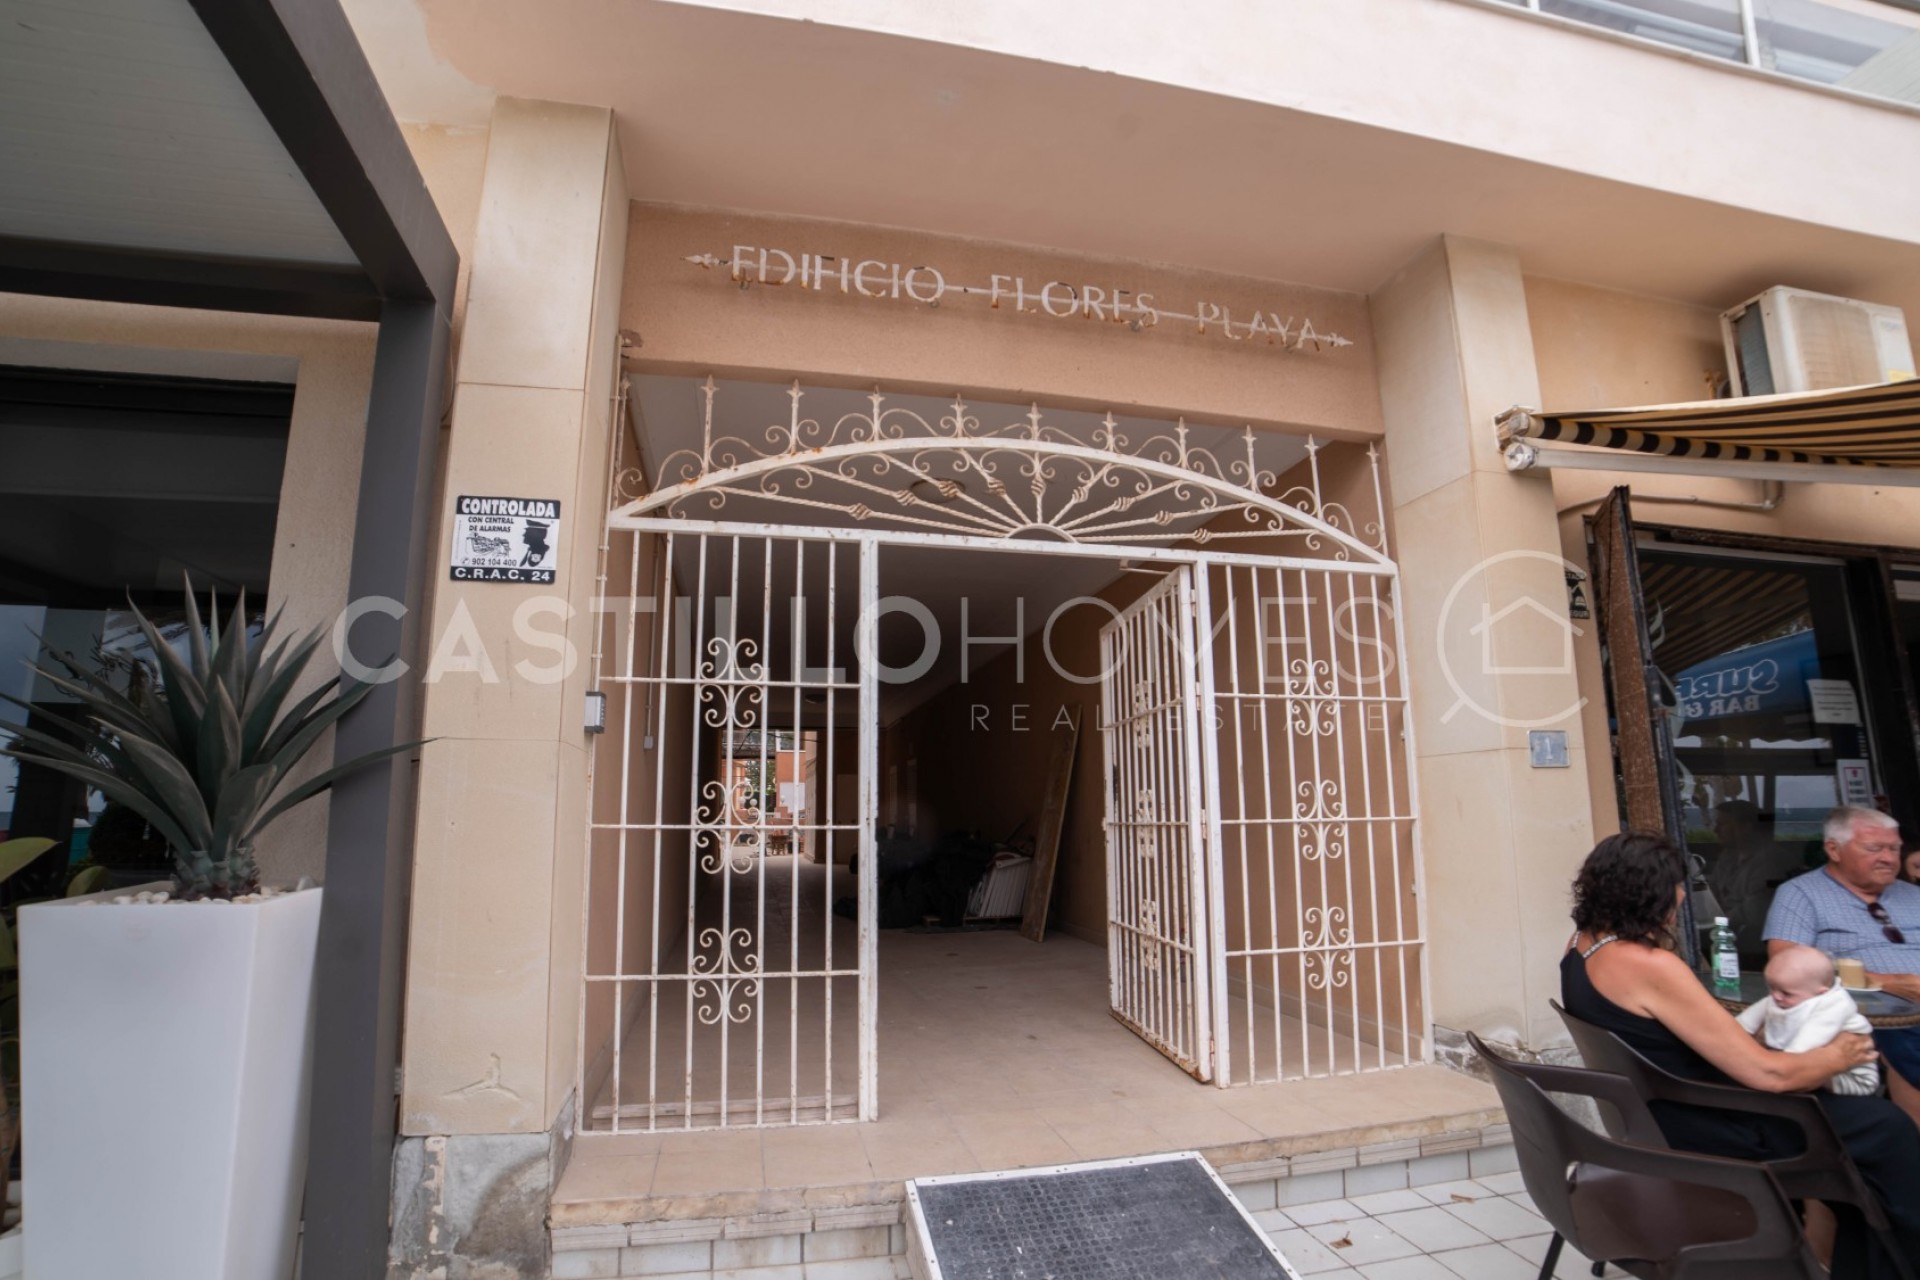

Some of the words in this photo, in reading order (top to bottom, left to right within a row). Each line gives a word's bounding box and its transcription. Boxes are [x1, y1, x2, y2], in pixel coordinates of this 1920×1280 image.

[731, 244, 945, 303] EDIFICIO
[990, 274, 1159, 328] FLORES
[1197, 301, 1321, 352] PLAYA
[461, 498, 556, 518] CONTROLADA
[484, 516, 515, 525] CENTRAL
[479, 525, 511, 533] ALARMAS
[472, 558, 485, 566] 902
[488, 558, 502, 566] 104
[503, 559, 517, 567] 400
[455, 567, 525, 580] C.R.A.C.
[531, 570, 551, 582] 24
